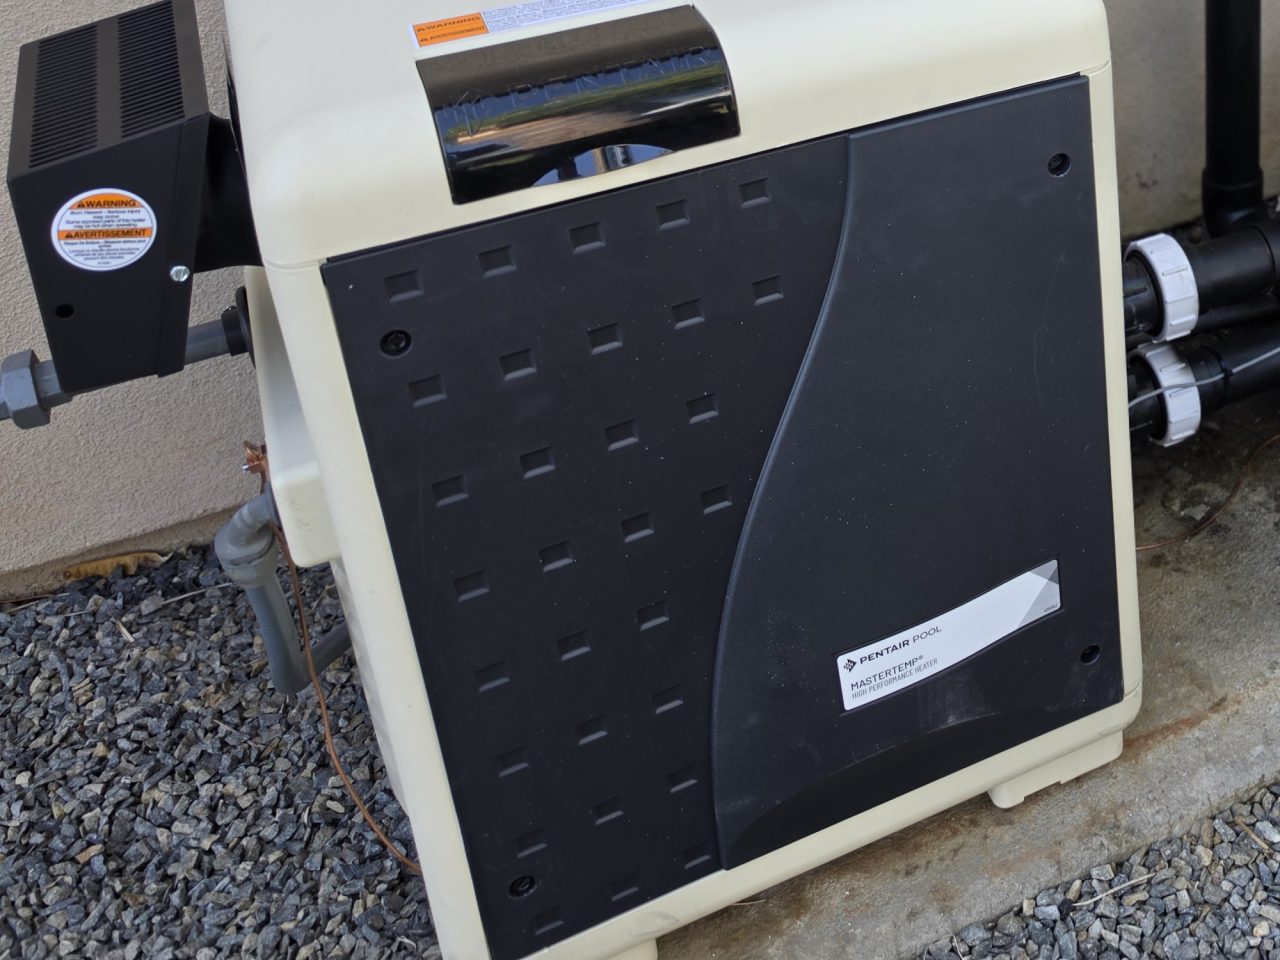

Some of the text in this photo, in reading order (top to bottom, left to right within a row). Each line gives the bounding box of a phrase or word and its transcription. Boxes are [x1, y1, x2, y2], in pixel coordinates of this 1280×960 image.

[85, 200, 136, 208] WARNING
[75, 229, 146, 238] AVERTISSEMENT
[859, 626, 942, 664] PENTAIR POOL
[852, 658, 938, 700] HIGH PERFORMANCE HEATER
